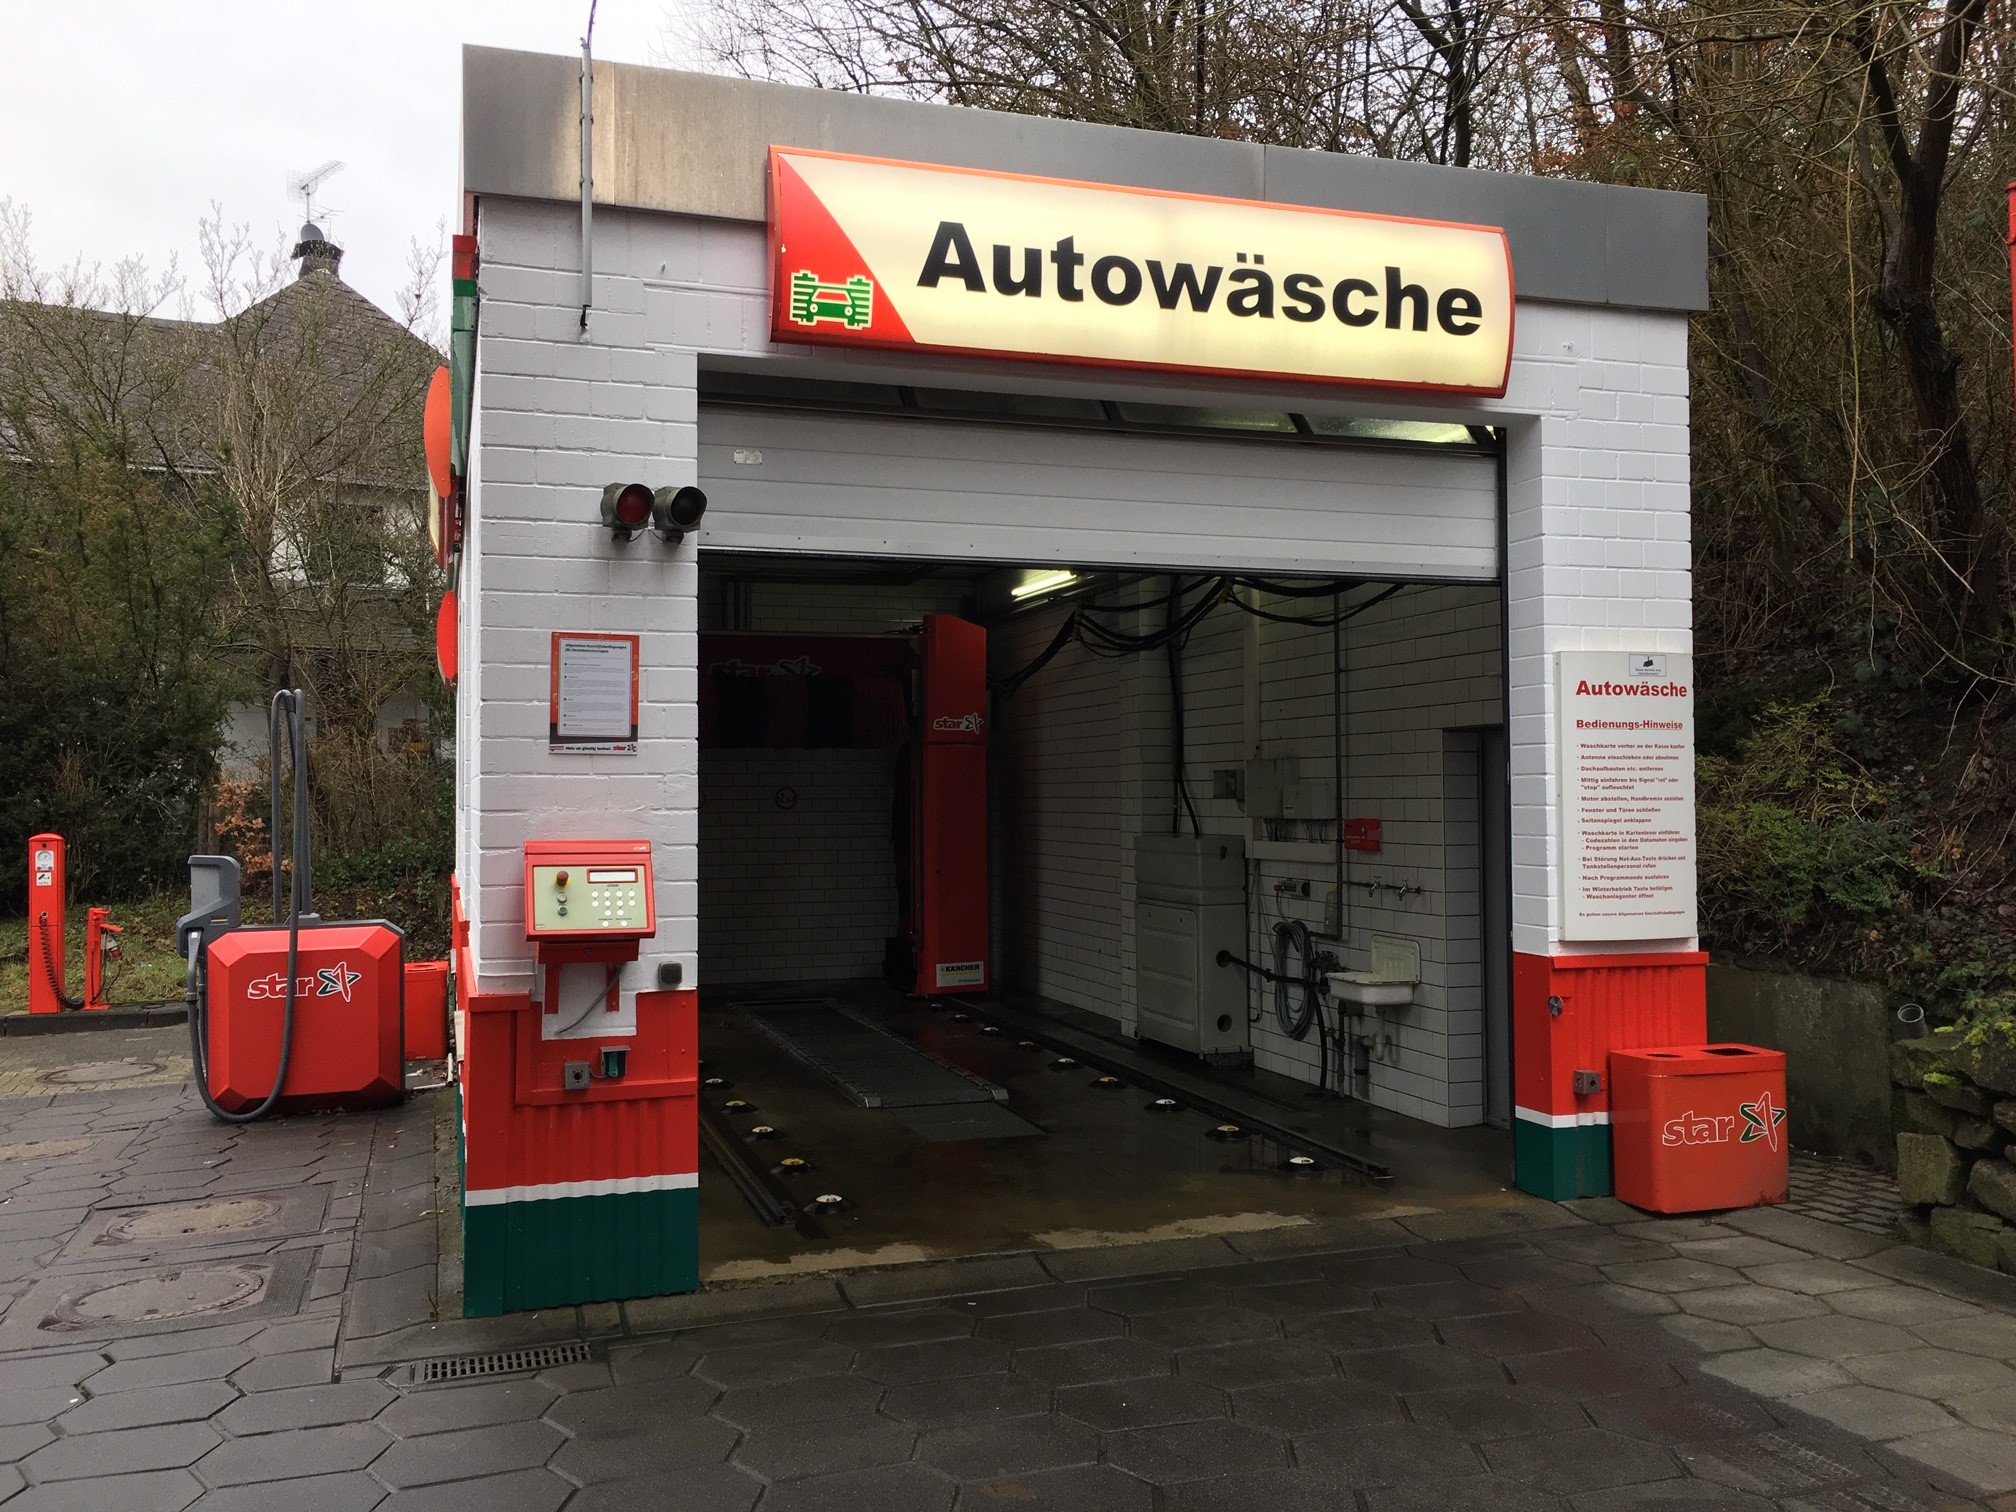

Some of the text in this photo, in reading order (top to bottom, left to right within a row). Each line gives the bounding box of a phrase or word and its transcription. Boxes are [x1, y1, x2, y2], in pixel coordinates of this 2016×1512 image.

[917, 221, 1482, 336] Autowäsche
[1576, 680, 1687, 697] Autowäsche
[933, 716, 963, 730] star
[1576, 720, 1683, 730] Bedienungs-Hinweise
[247, 972, 314, 1000] star
[1662, 1110, 1734, 1146] star
